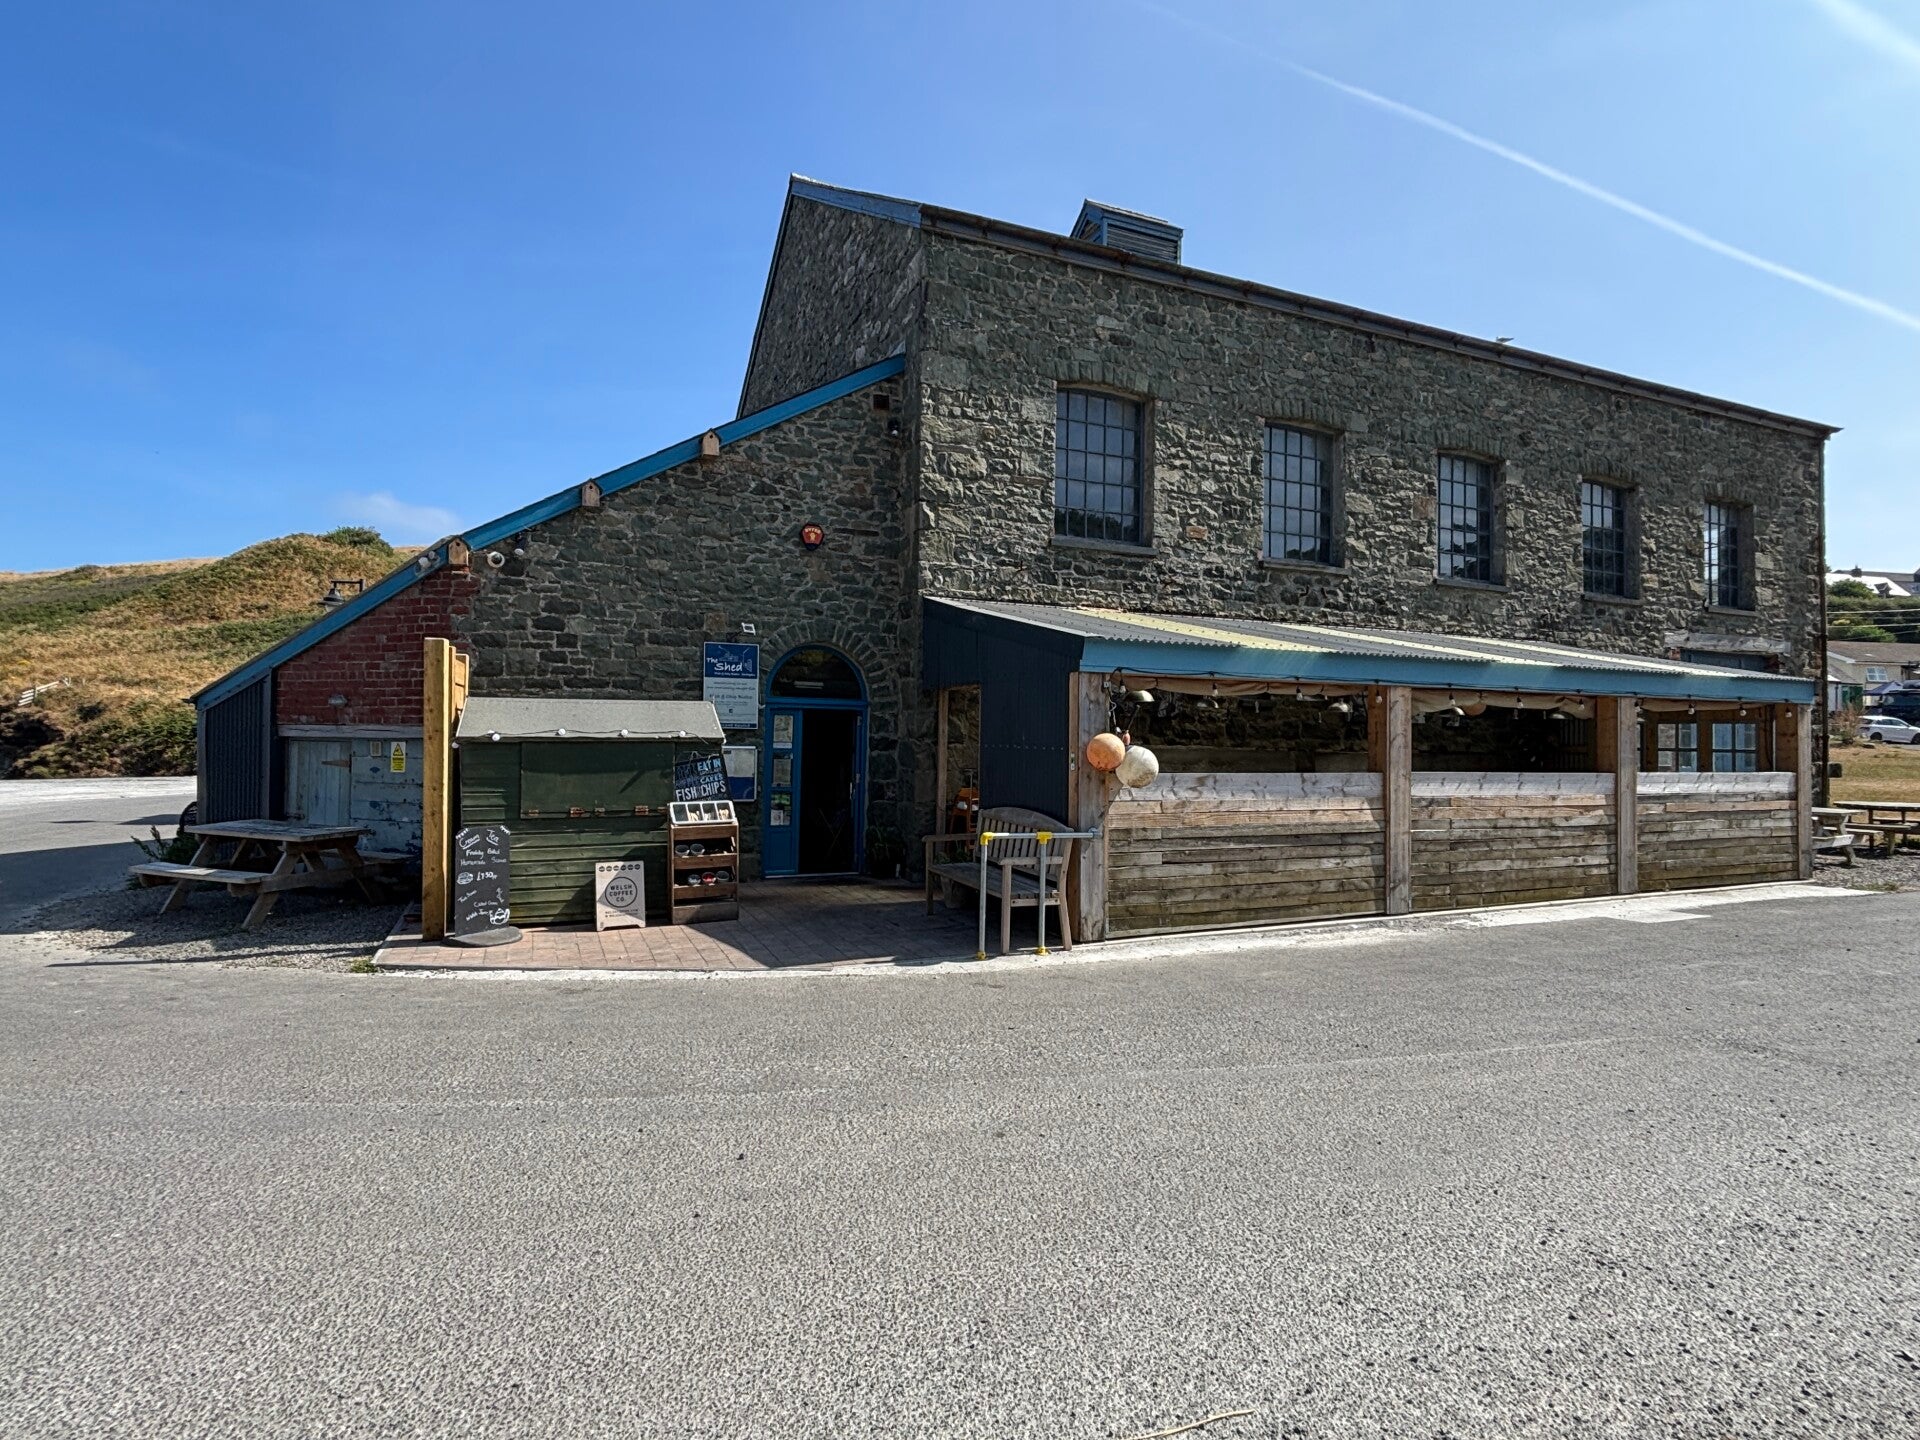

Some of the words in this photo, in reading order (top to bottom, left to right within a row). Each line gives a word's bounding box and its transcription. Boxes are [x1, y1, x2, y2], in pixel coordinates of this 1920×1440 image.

[714, 662, 743, 672] Shed
[697, 760, 711, 771] EAT
[712, 758, 721, 768] IN
[675, 786, 698, 802] FISH
[700, 780, 726, 797] CHIPS
[459, 834, 480, 848] Cream
[486, 829, 499, 842] Tea
